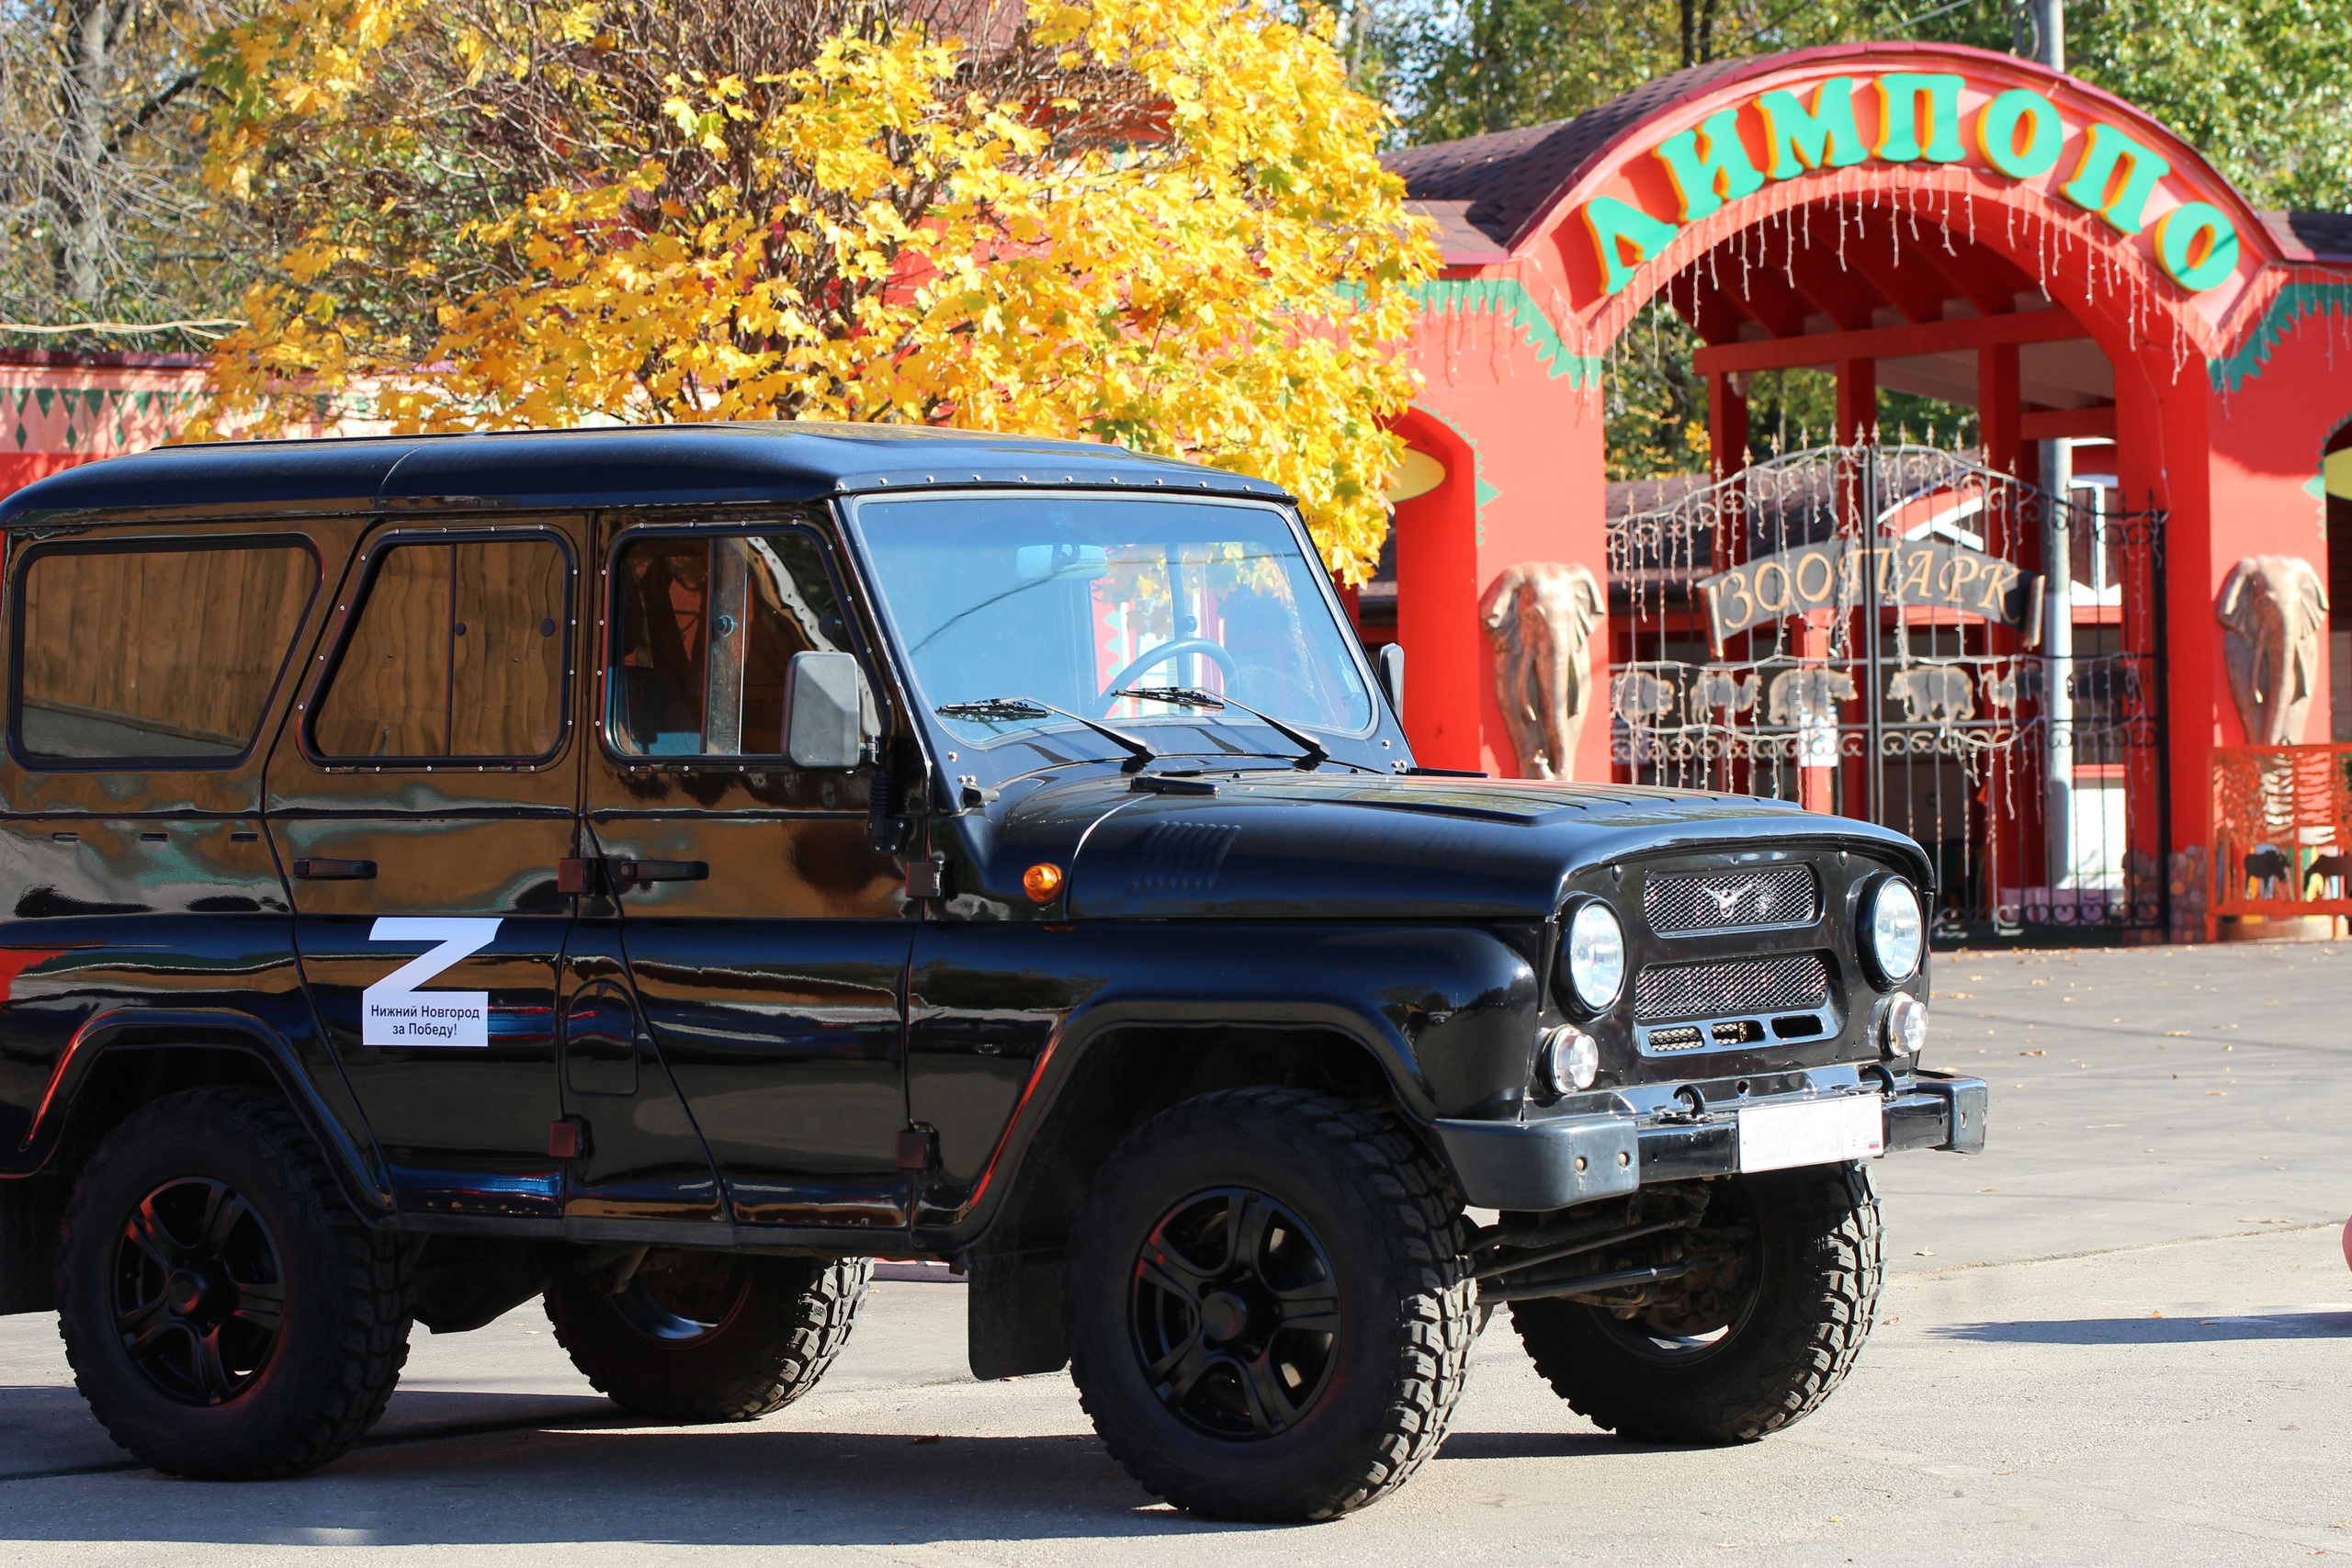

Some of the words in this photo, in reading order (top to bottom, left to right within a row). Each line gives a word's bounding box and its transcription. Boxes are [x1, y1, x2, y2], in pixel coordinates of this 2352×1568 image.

[1581, 73, 2240, 296] ЛИМПОПО
[1719, 548, 2020, 629] ЗООПАРК
[362, 917, 504, 1046] Z
[371, 1005, 417, 1017] Нижний
[421, 1006, 480, 1020] Новгород
[392, 1025, 405, 1034] за
[409, 1022, 458, 1038] Победу!
